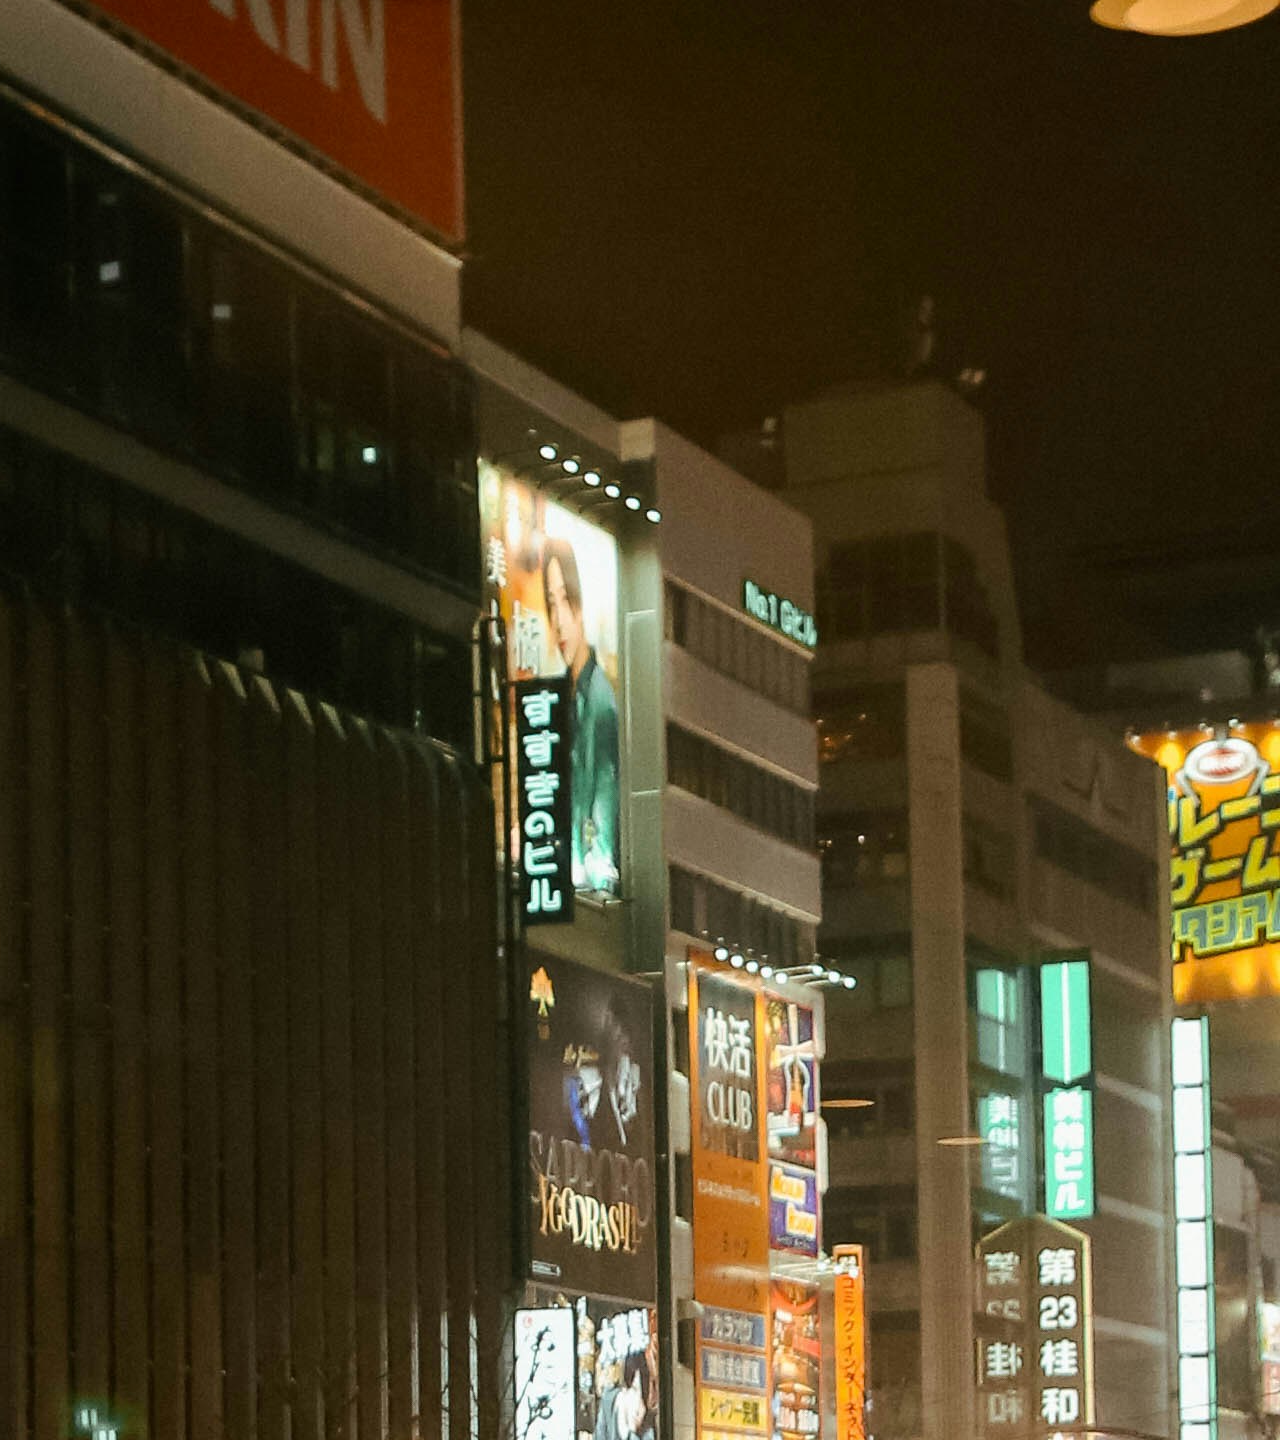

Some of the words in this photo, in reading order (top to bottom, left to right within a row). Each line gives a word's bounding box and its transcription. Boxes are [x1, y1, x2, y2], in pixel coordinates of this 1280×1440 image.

[521, 688, 561, 913] すすきのビル
[1172, 888, 1280, 961] タジア
[704, 1007, 753, 1078] 快活
[706, 1079, 753, 1131] CLUB
